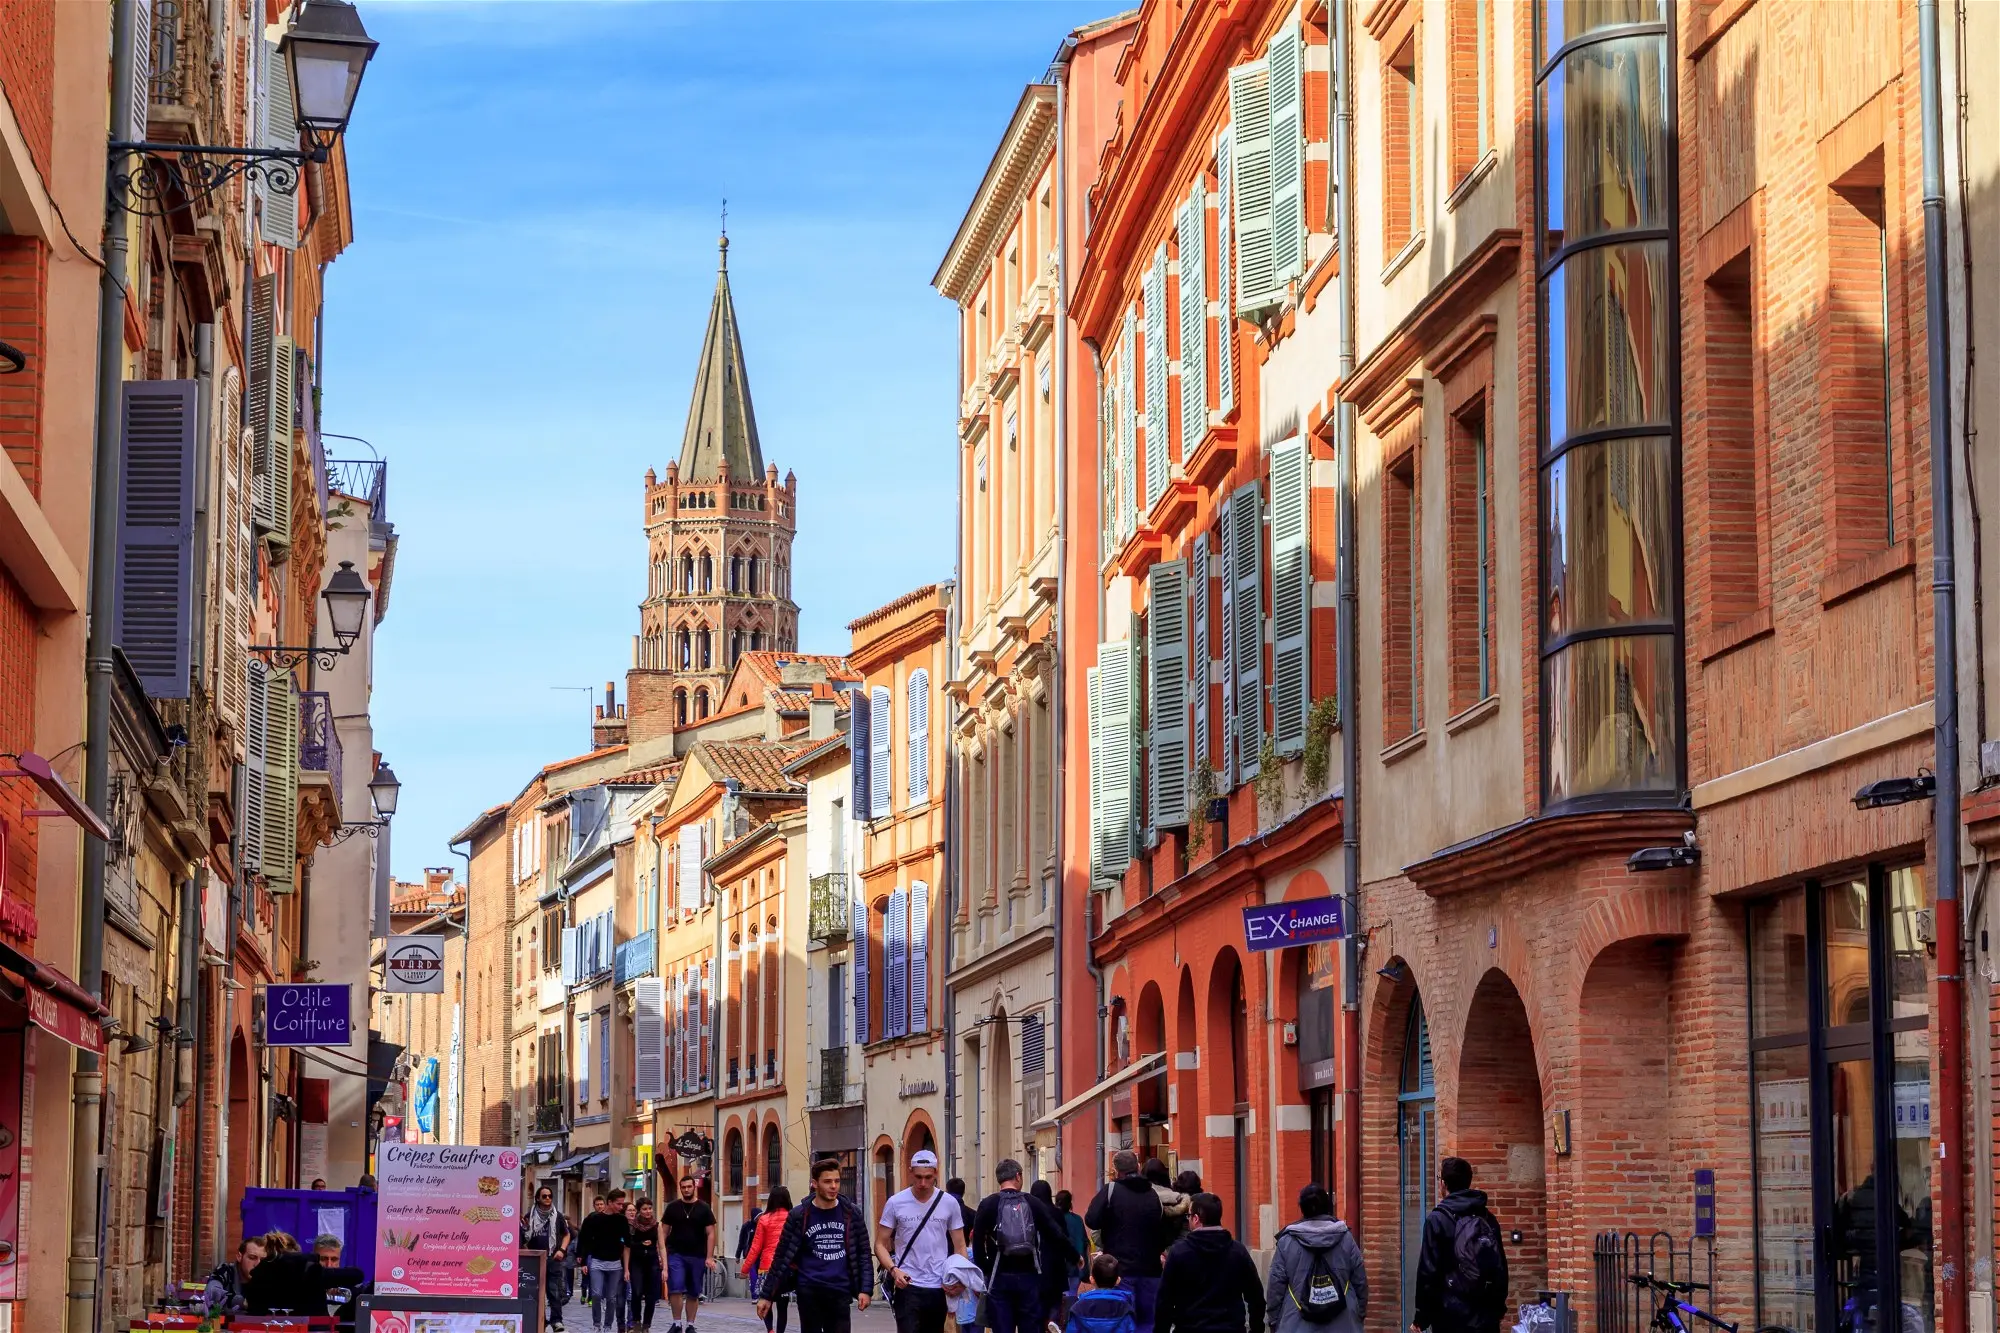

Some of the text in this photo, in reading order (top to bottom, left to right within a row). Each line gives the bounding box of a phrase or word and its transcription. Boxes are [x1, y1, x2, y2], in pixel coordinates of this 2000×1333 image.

[1247, 913, 1337, 940] EX CHANGE
[282, 988, 332, 1007] Odile
[273, 1008, 346, 1040] Coiffure
[440, 1148, 495, 1170] Gaufres
[387, 1174, 445, 1186] Gaufre de Liège
[386, 1205, 461, 1215] Gaufre de Bruxelles
[422, 1231, 470, 1243] Gaufre Lolly
[805, 1223, 822, 1238] ZADIG
